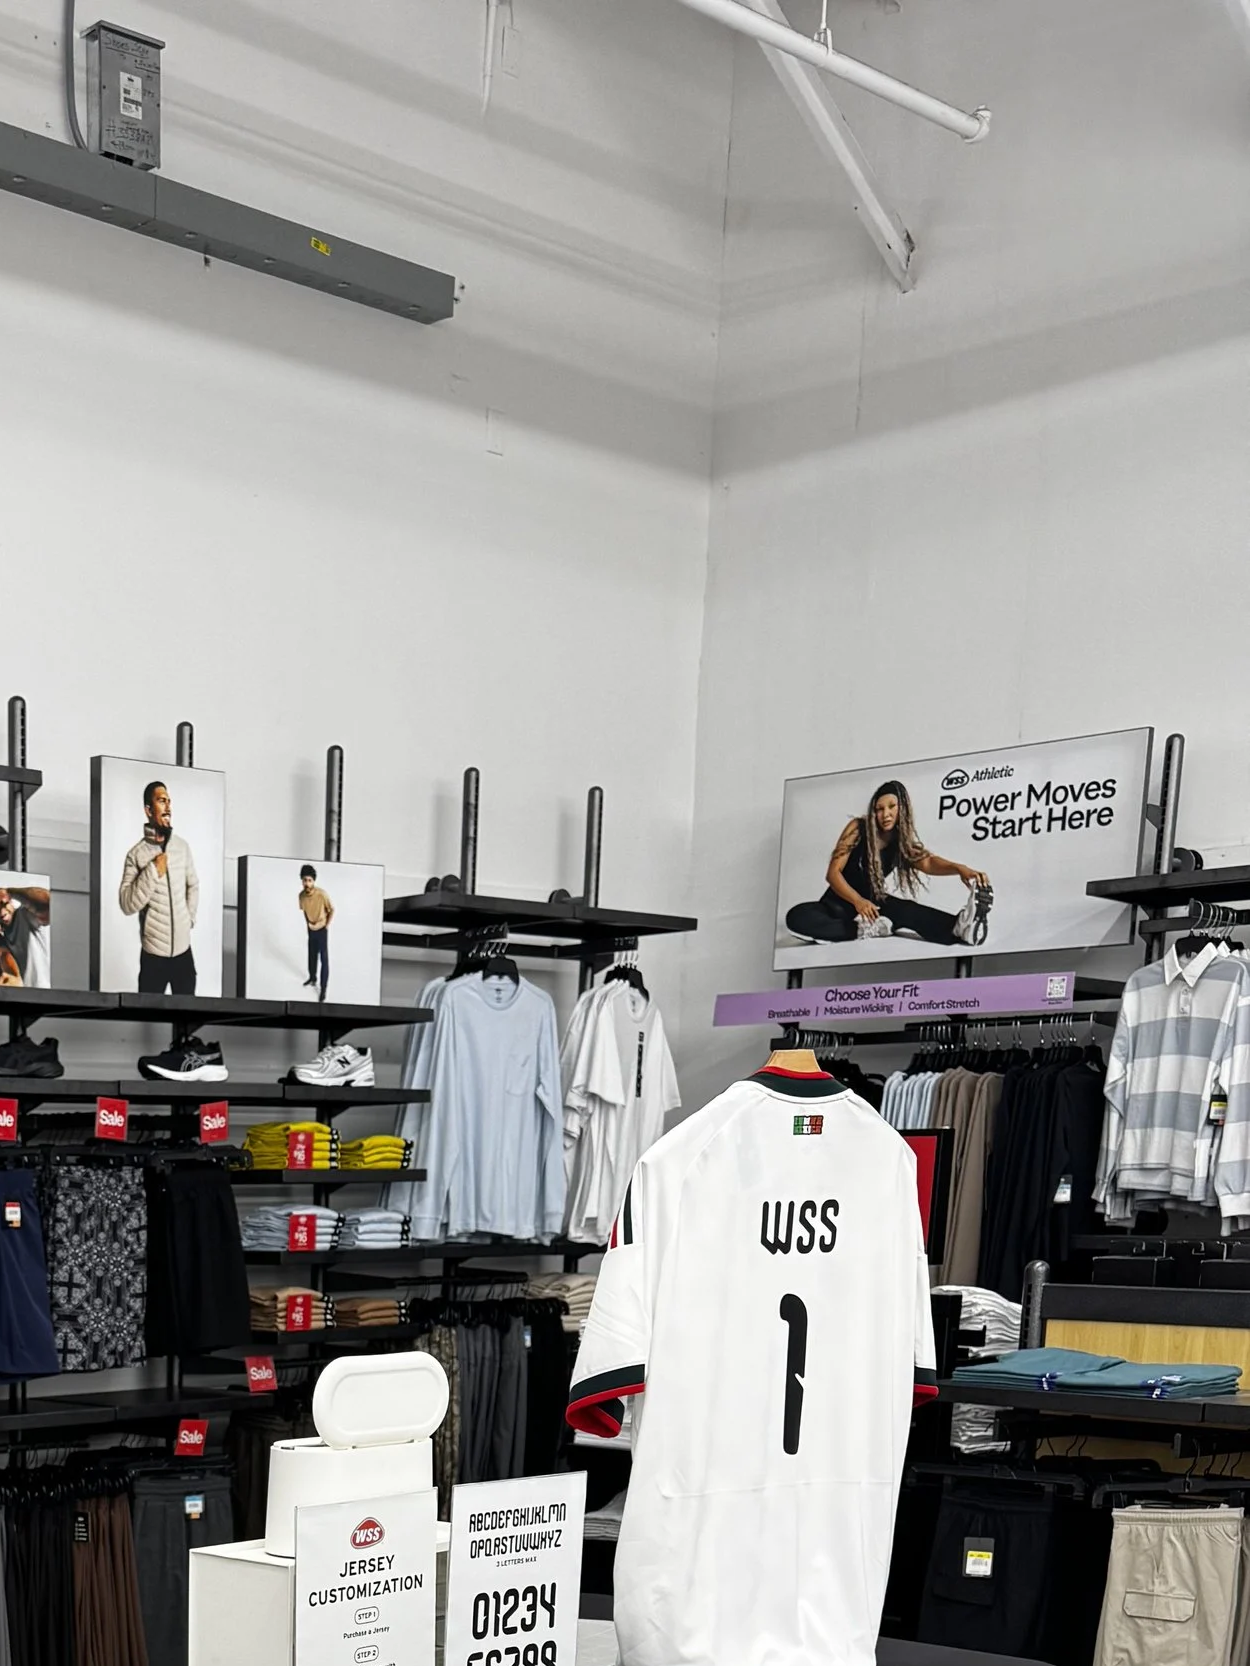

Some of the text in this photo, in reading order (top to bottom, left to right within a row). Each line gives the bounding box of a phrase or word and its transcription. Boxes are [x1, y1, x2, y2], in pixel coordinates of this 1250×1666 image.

[971, 765, 1015, 783] Athletic
[938, 778, 1118, 820] Power Moves
[971, 805, 1114, 842] Start Here
[824, 984, 920, 1003] Choose Your Fit
[768, 1007, 811, 1019] Breathable
[824, 1002, 894, 1016] Moisture Wicking
[908, 998, 980, 1011] Comfort Stretch
[99, 1109, 125, 1127] Sale
[202, 1113, 226, 1131] Sale
[761, 1199, 839, 1255] WSS
[250, 1366, 273, 1380] Sale
[779, 1293, 808, 1455] 1
[180, 1430, 204, 1444] Sale
[354, 1527, 381, 1544] WSS
[339, 1554, 395, 1578] JERSEY
[501, 1557, 524, 1567] LETTERS
[308, 1573, 423, 1607] CUSTOMIZATION
[358, 1611, 372, 1620] STEP
[472, 1582, 557, 1640] 01234
[343, 1630, 367, 1639] Purchase
[373, 1626, 390, 1634] Jersey
[357, 1650, 372, 1660] STEP
